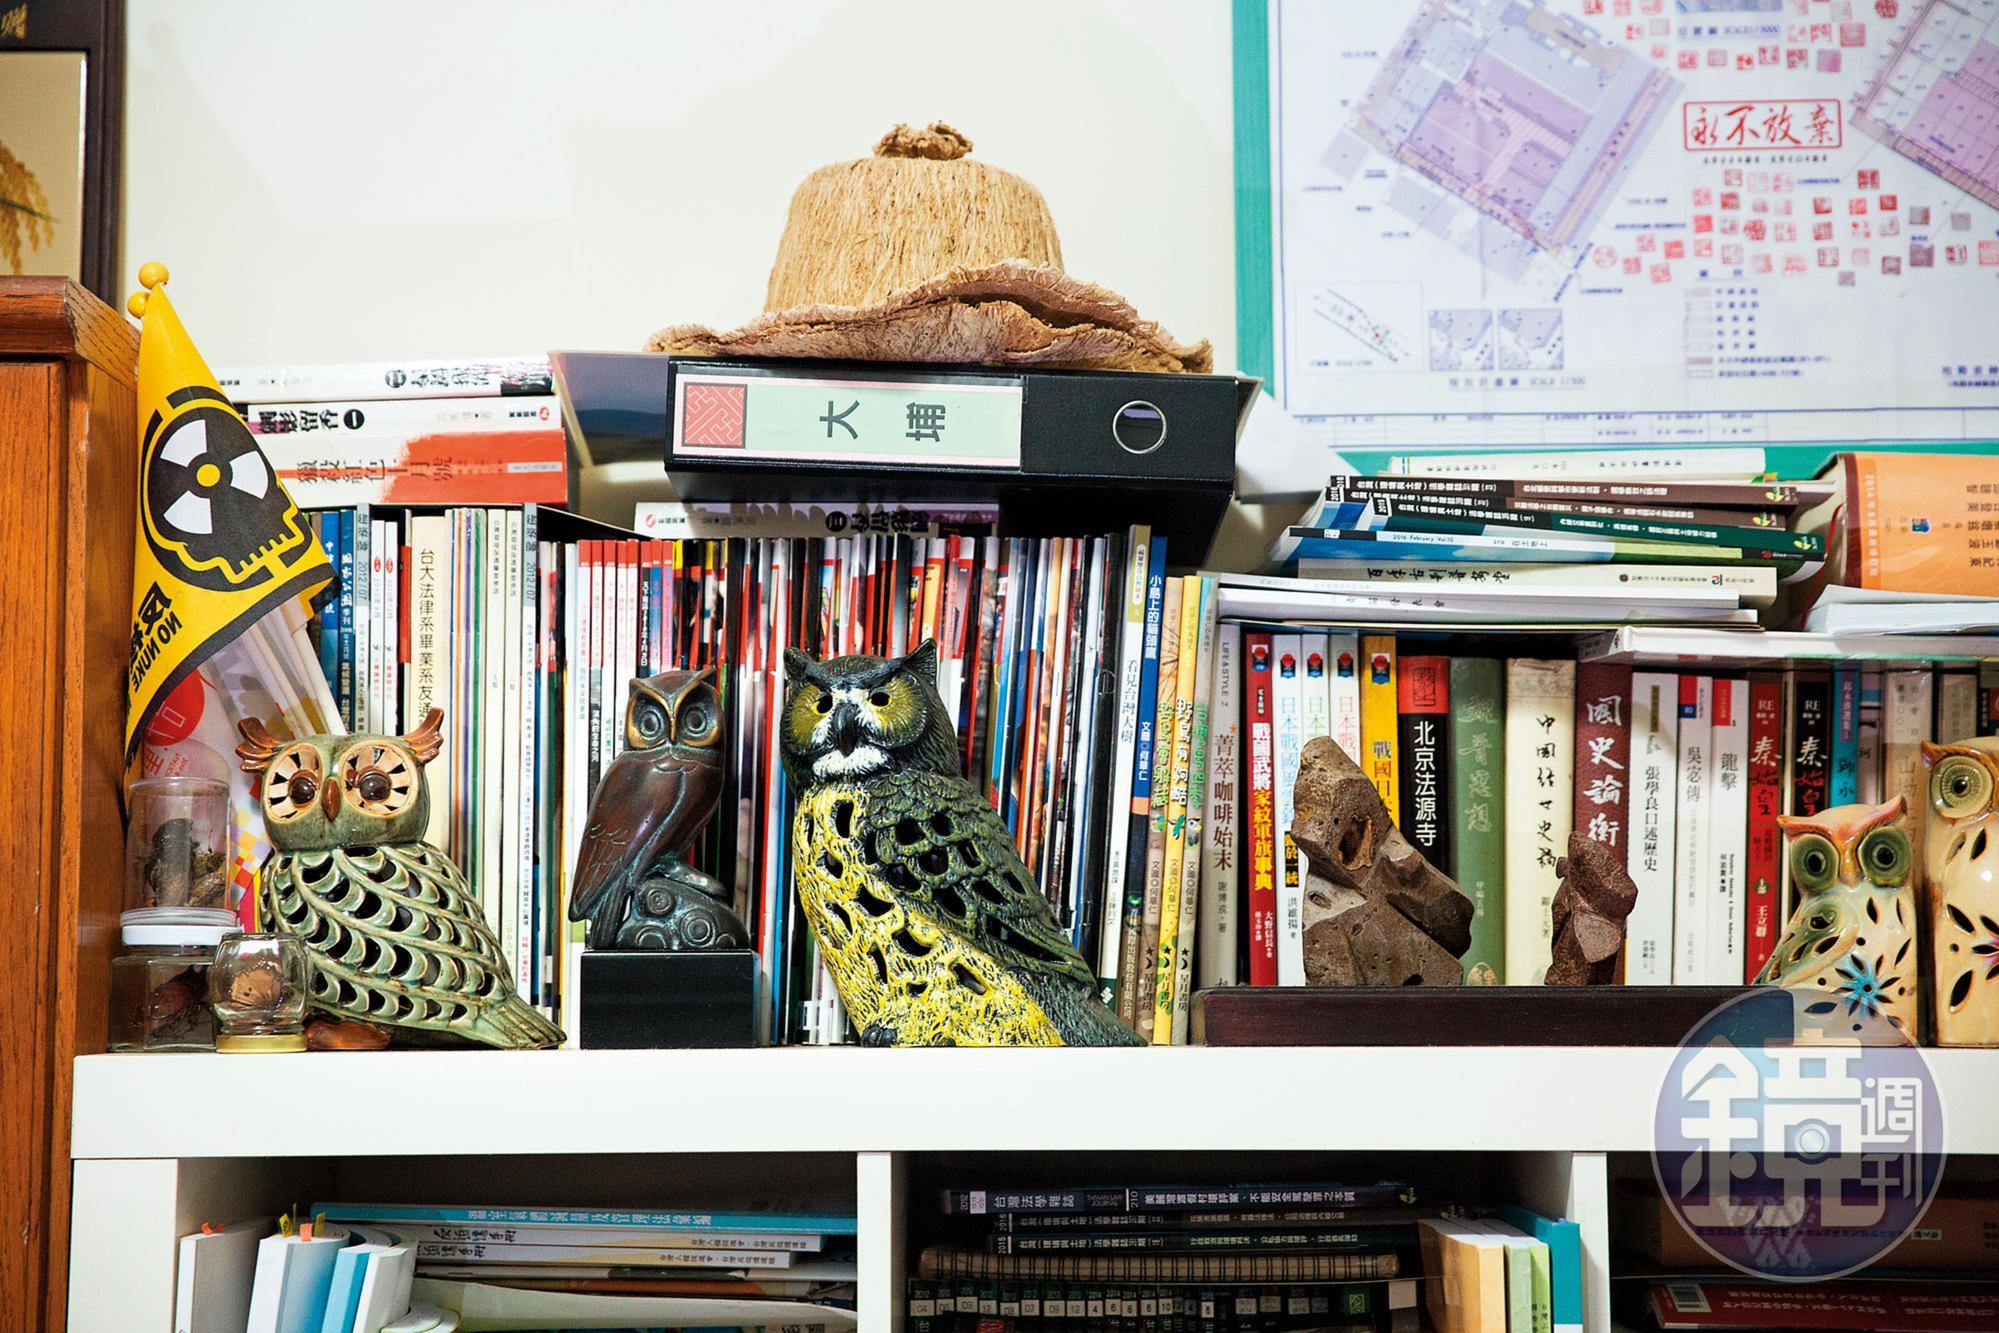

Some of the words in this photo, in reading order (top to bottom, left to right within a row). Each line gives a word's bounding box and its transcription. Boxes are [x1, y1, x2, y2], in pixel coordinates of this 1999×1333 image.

[1691, 104, 1835, 146] 永不放棄
[819, 399, 947, 443] 大埔
[418, 548, 436, 726] 台大法律系畢業系友通
[1413, 720, 1438, 848] 北京法源寺
[1457, 694, 1499, 835] 魏晉思想
[1582, 694, 1626, 848] 國史論衡
[1686, 745, 1702, 804] 吳宓傳
[1750, 735, 1782, 816] 秦始皇
[1795, 735, 1828, 816] 秦始皇
[1252, 722, 1272, 891] 戰國武將家紋軍旗事典
[1643, 765, 1661, 873] 張學良口述歷史
[1756, 905, 1769, 938] 王立群
[993, 1194, 1075, 1208] 台灣法學雜誌
[1130, 1191, 1139, 1208] 210
[418, 1242, 487, 1258] 迫遷手冊
[433, 1227, 517, 1243] 反迫遷手冊
